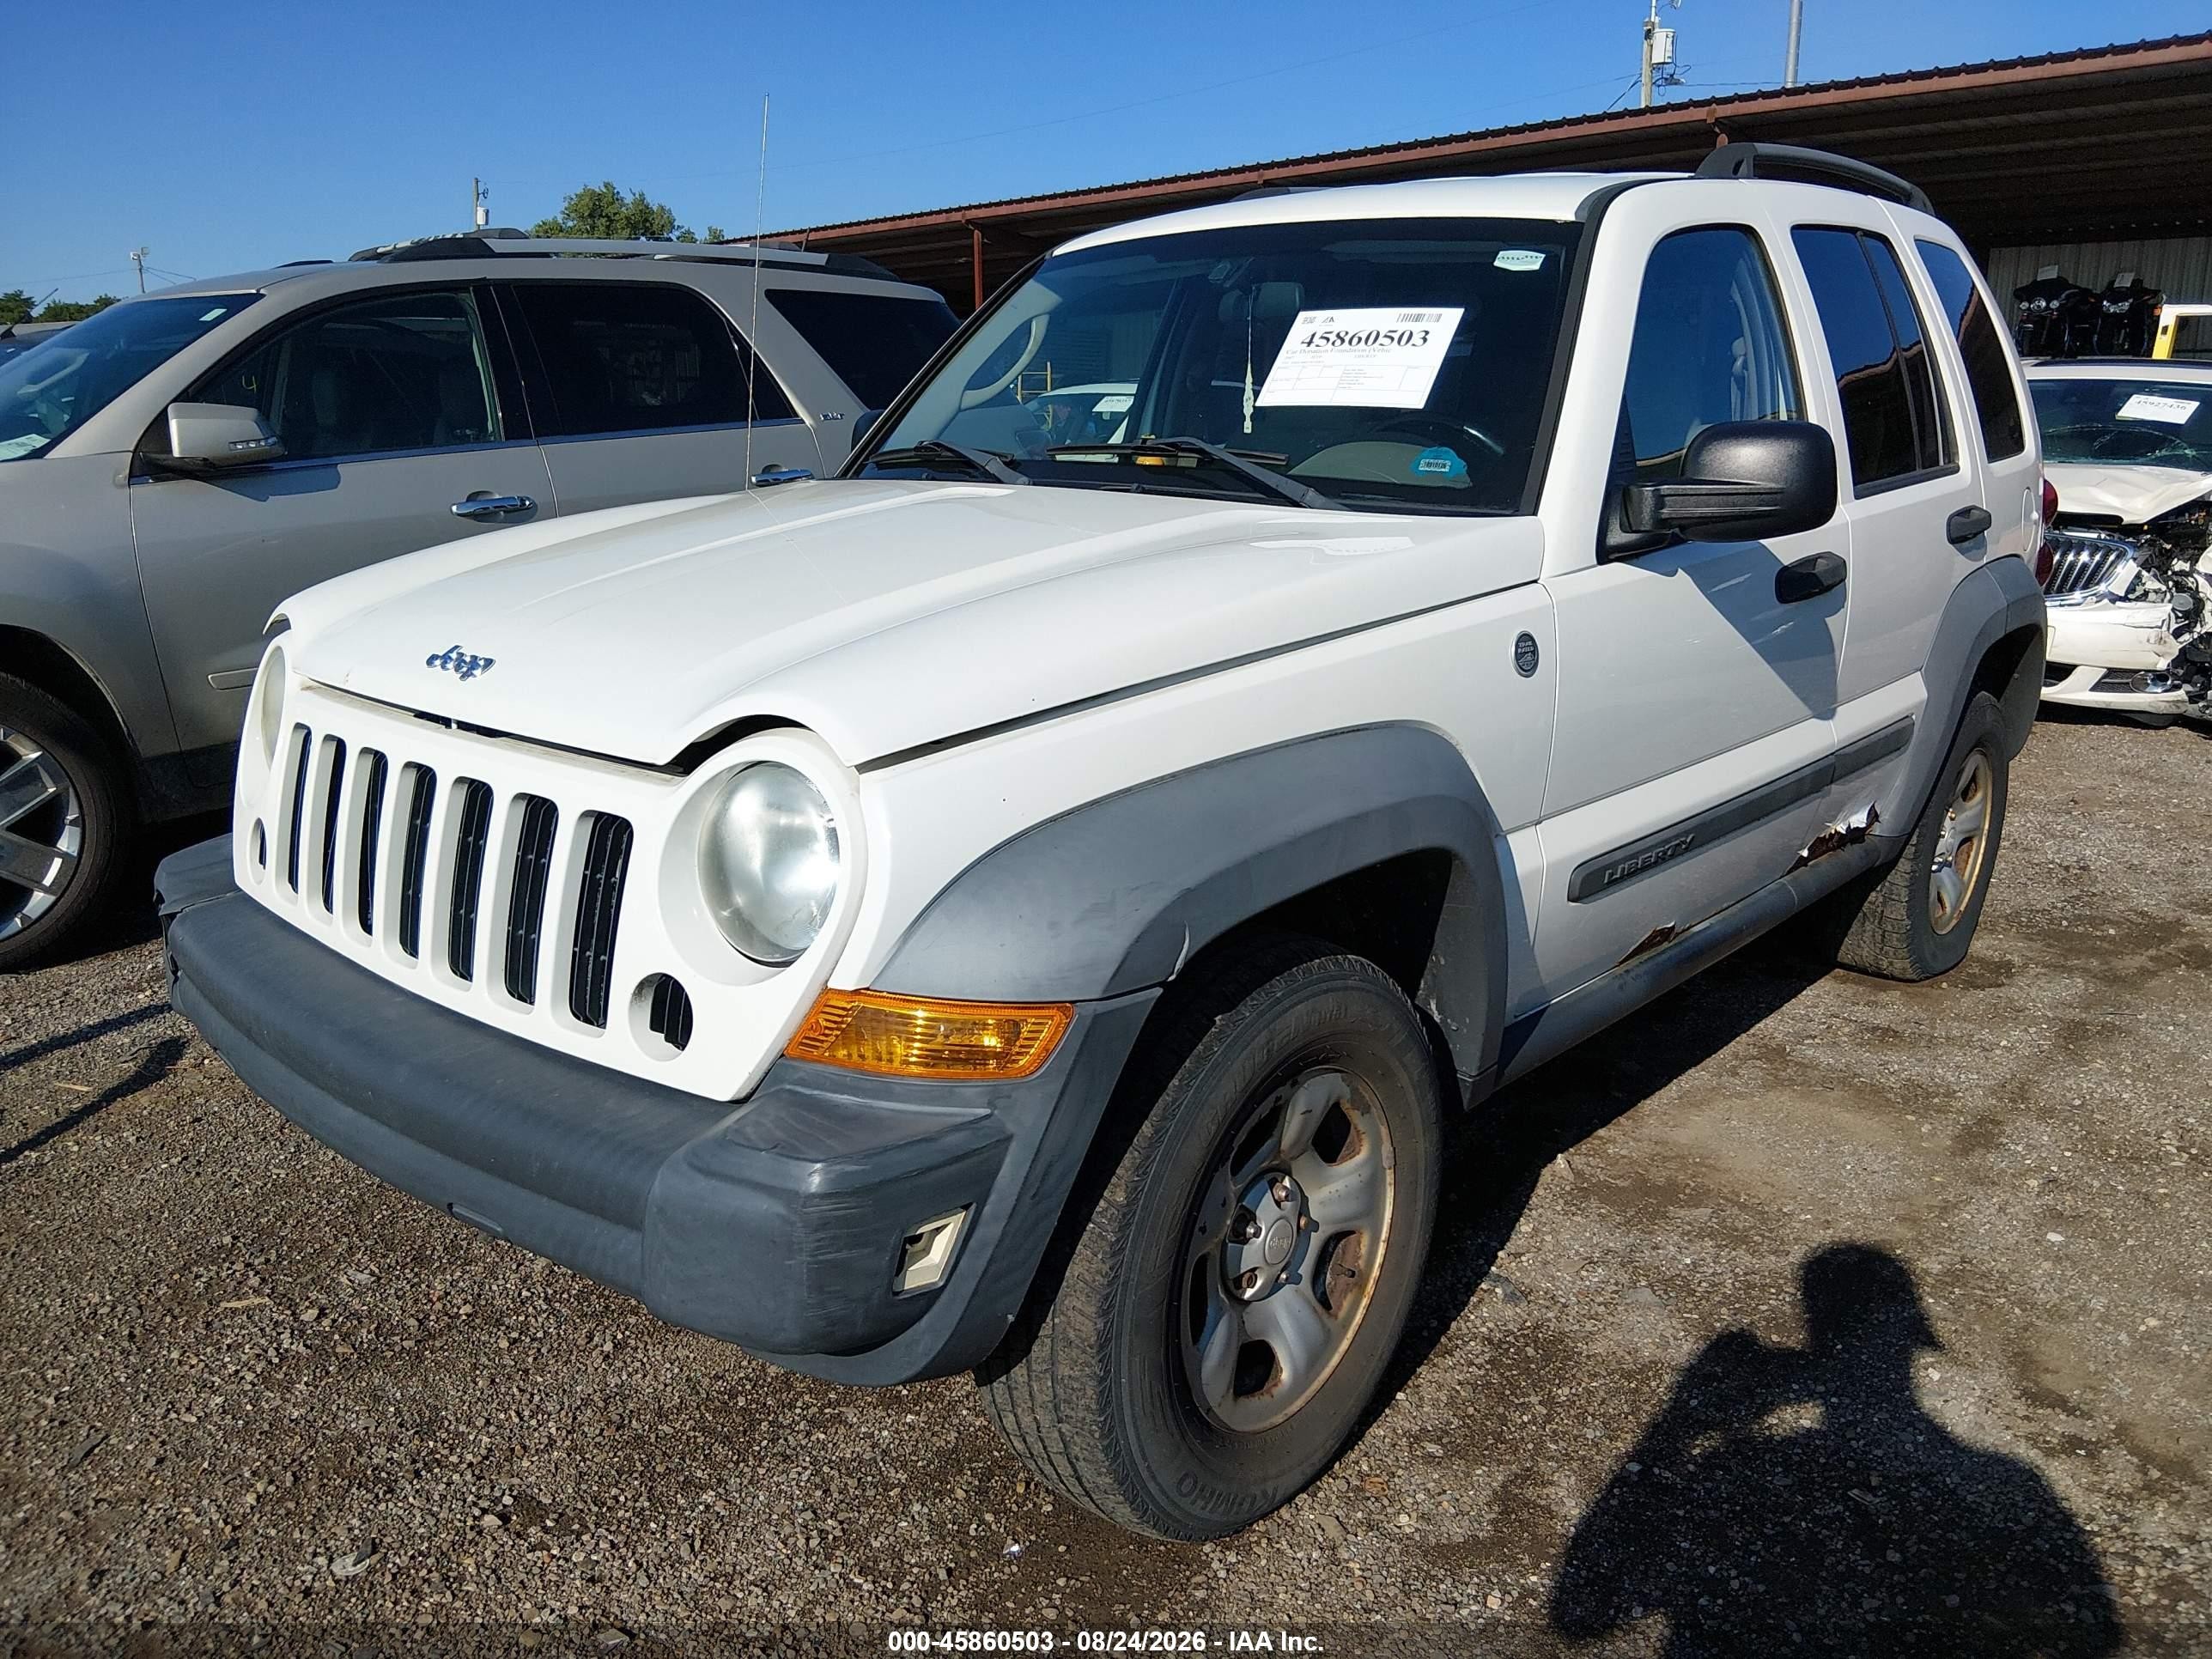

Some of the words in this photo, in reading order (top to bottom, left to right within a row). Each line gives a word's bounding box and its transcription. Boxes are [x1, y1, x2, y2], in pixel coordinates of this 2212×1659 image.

[1300, 329, 1431, 348] 45860503
[425, 644, 496, 681] Jeep
[1603, 833, 1695, 884] LIBERTY
